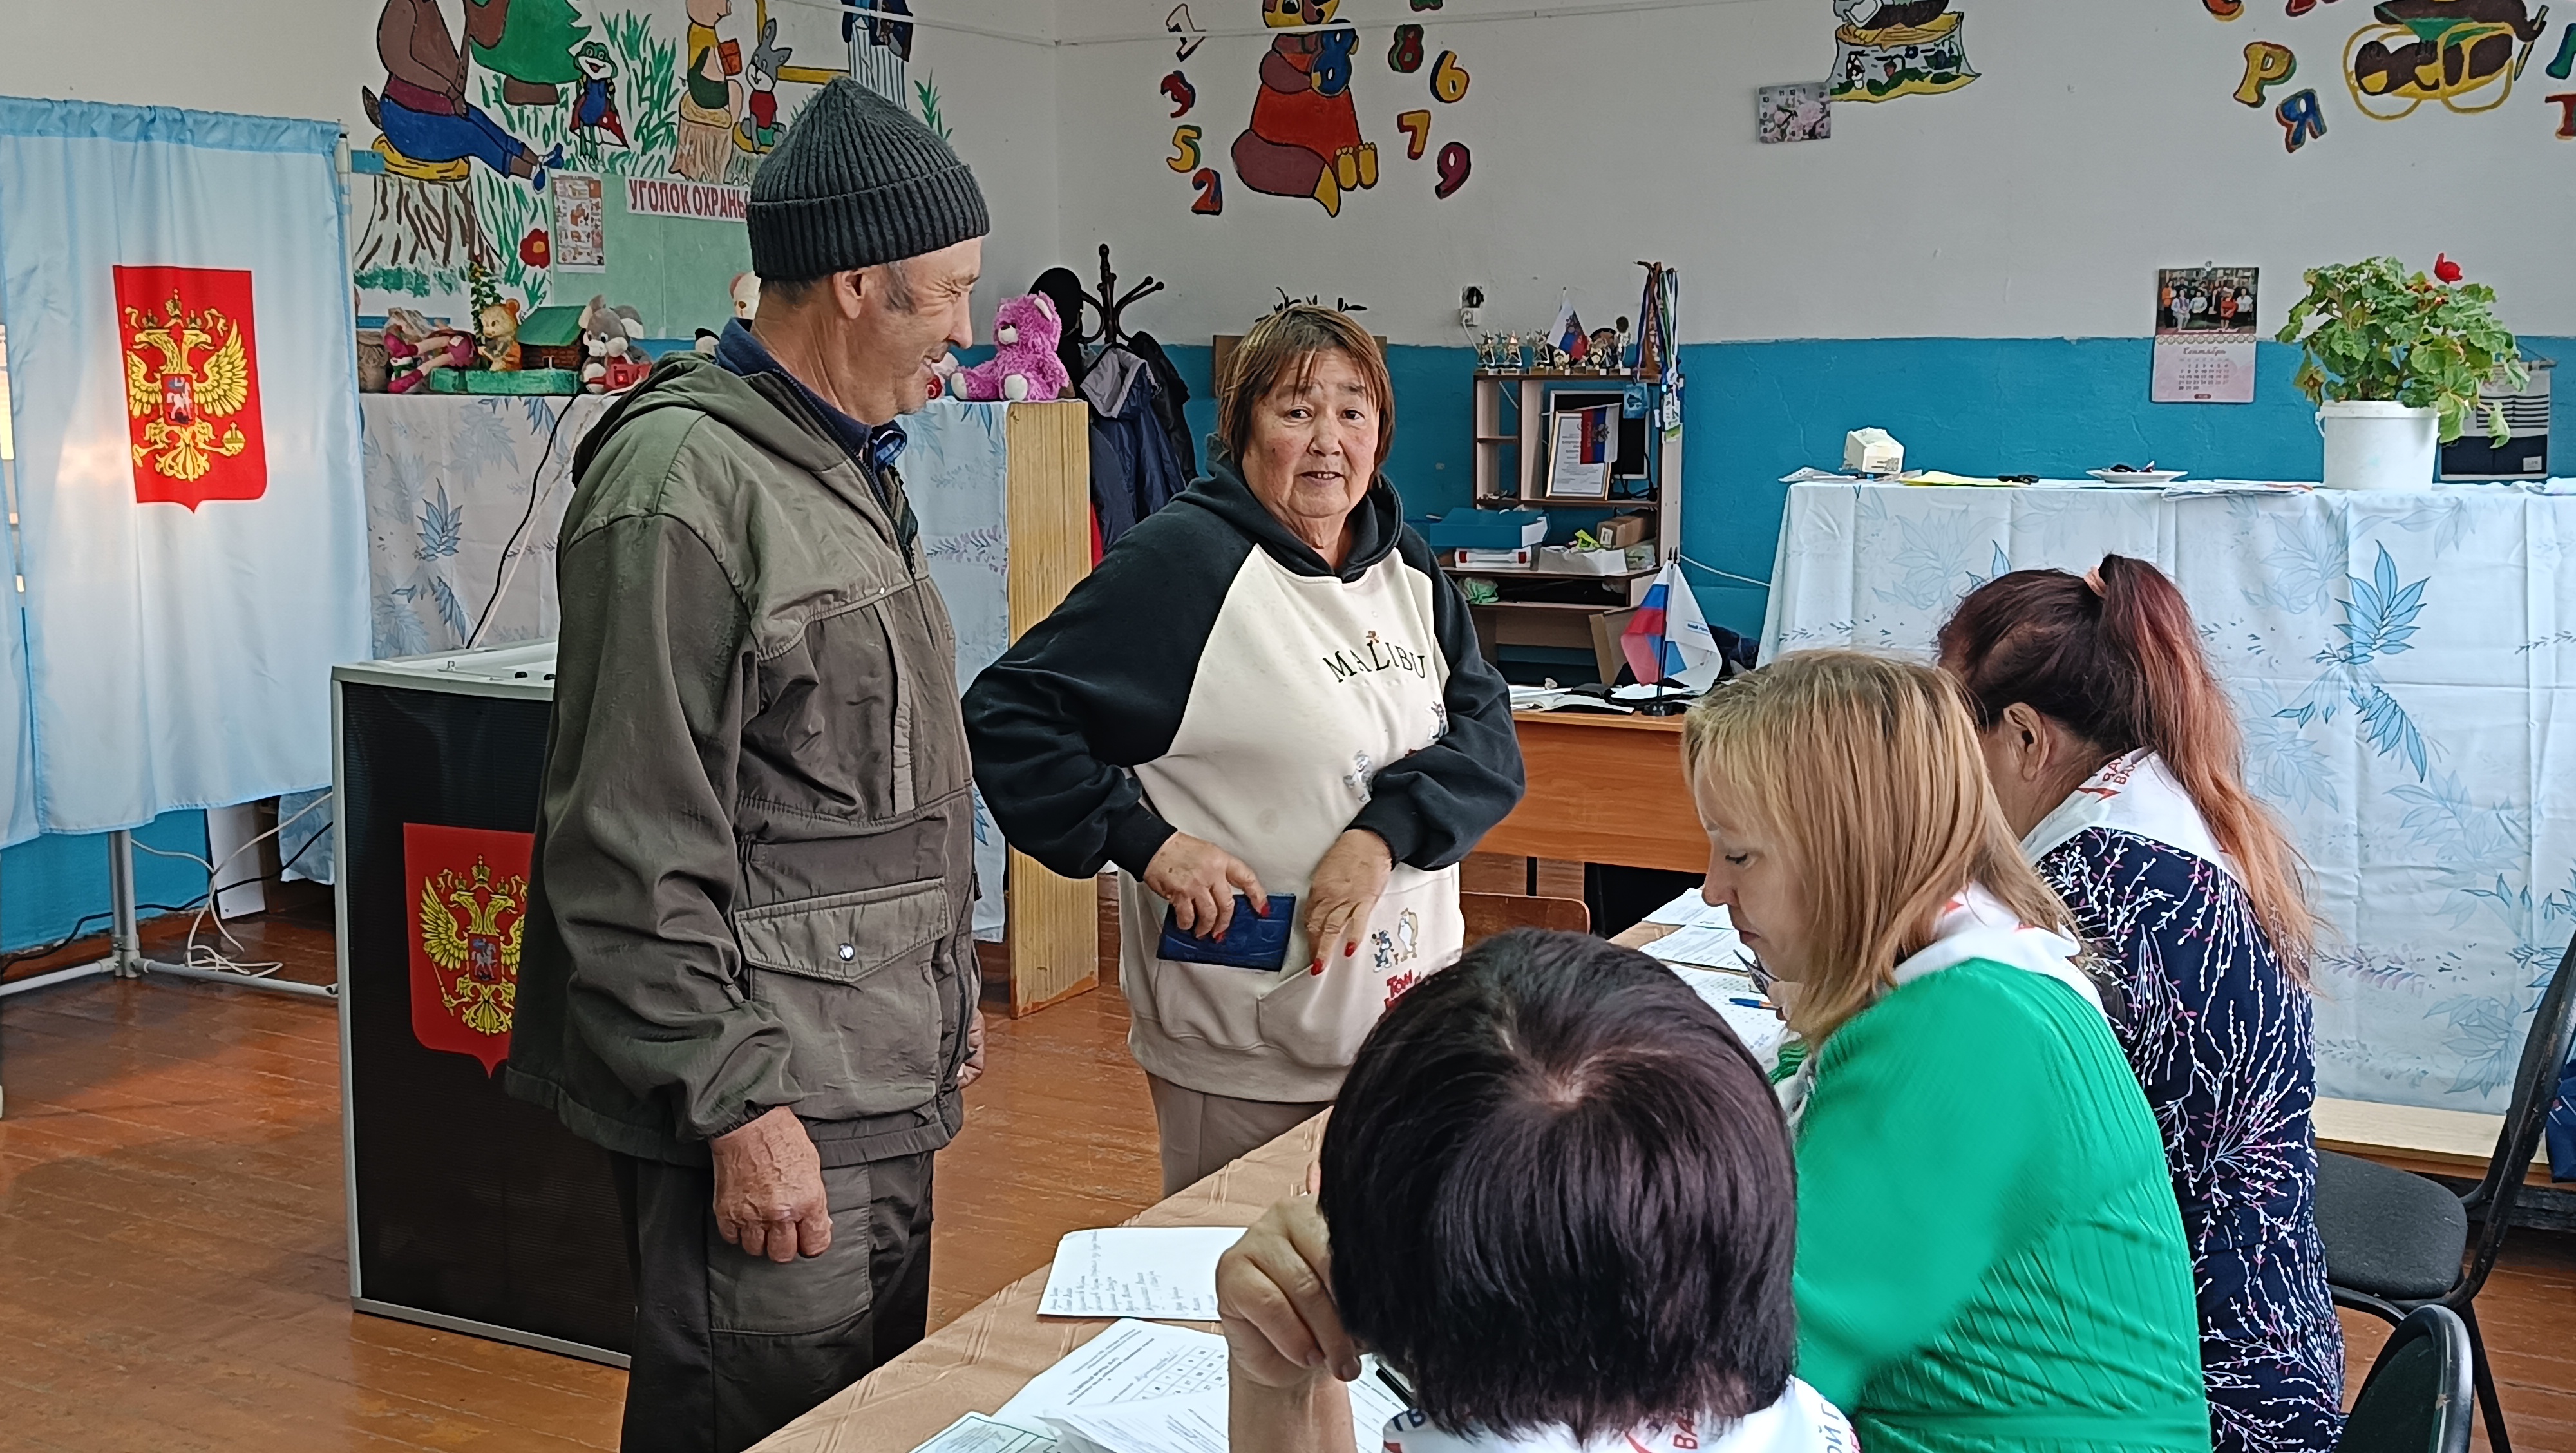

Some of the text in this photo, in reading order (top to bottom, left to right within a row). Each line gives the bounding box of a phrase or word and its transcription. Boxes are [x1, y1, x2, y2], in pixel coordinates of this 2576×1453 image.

[1387, 24, 1425, 73] 8
[1430, 50, 1470, 103] 6
[1397, 109, 1431, 160] 7
[2275, 88, 2327, 153] Я
[1166, 125, 1202, 173] 5
[1435, 142, 1471, 200] 9
[629, 179, 692, 214] УГОЛОК
[1191, 168, 1223, 216] 2
[1323, 642, 1425, 683] MALIBU
